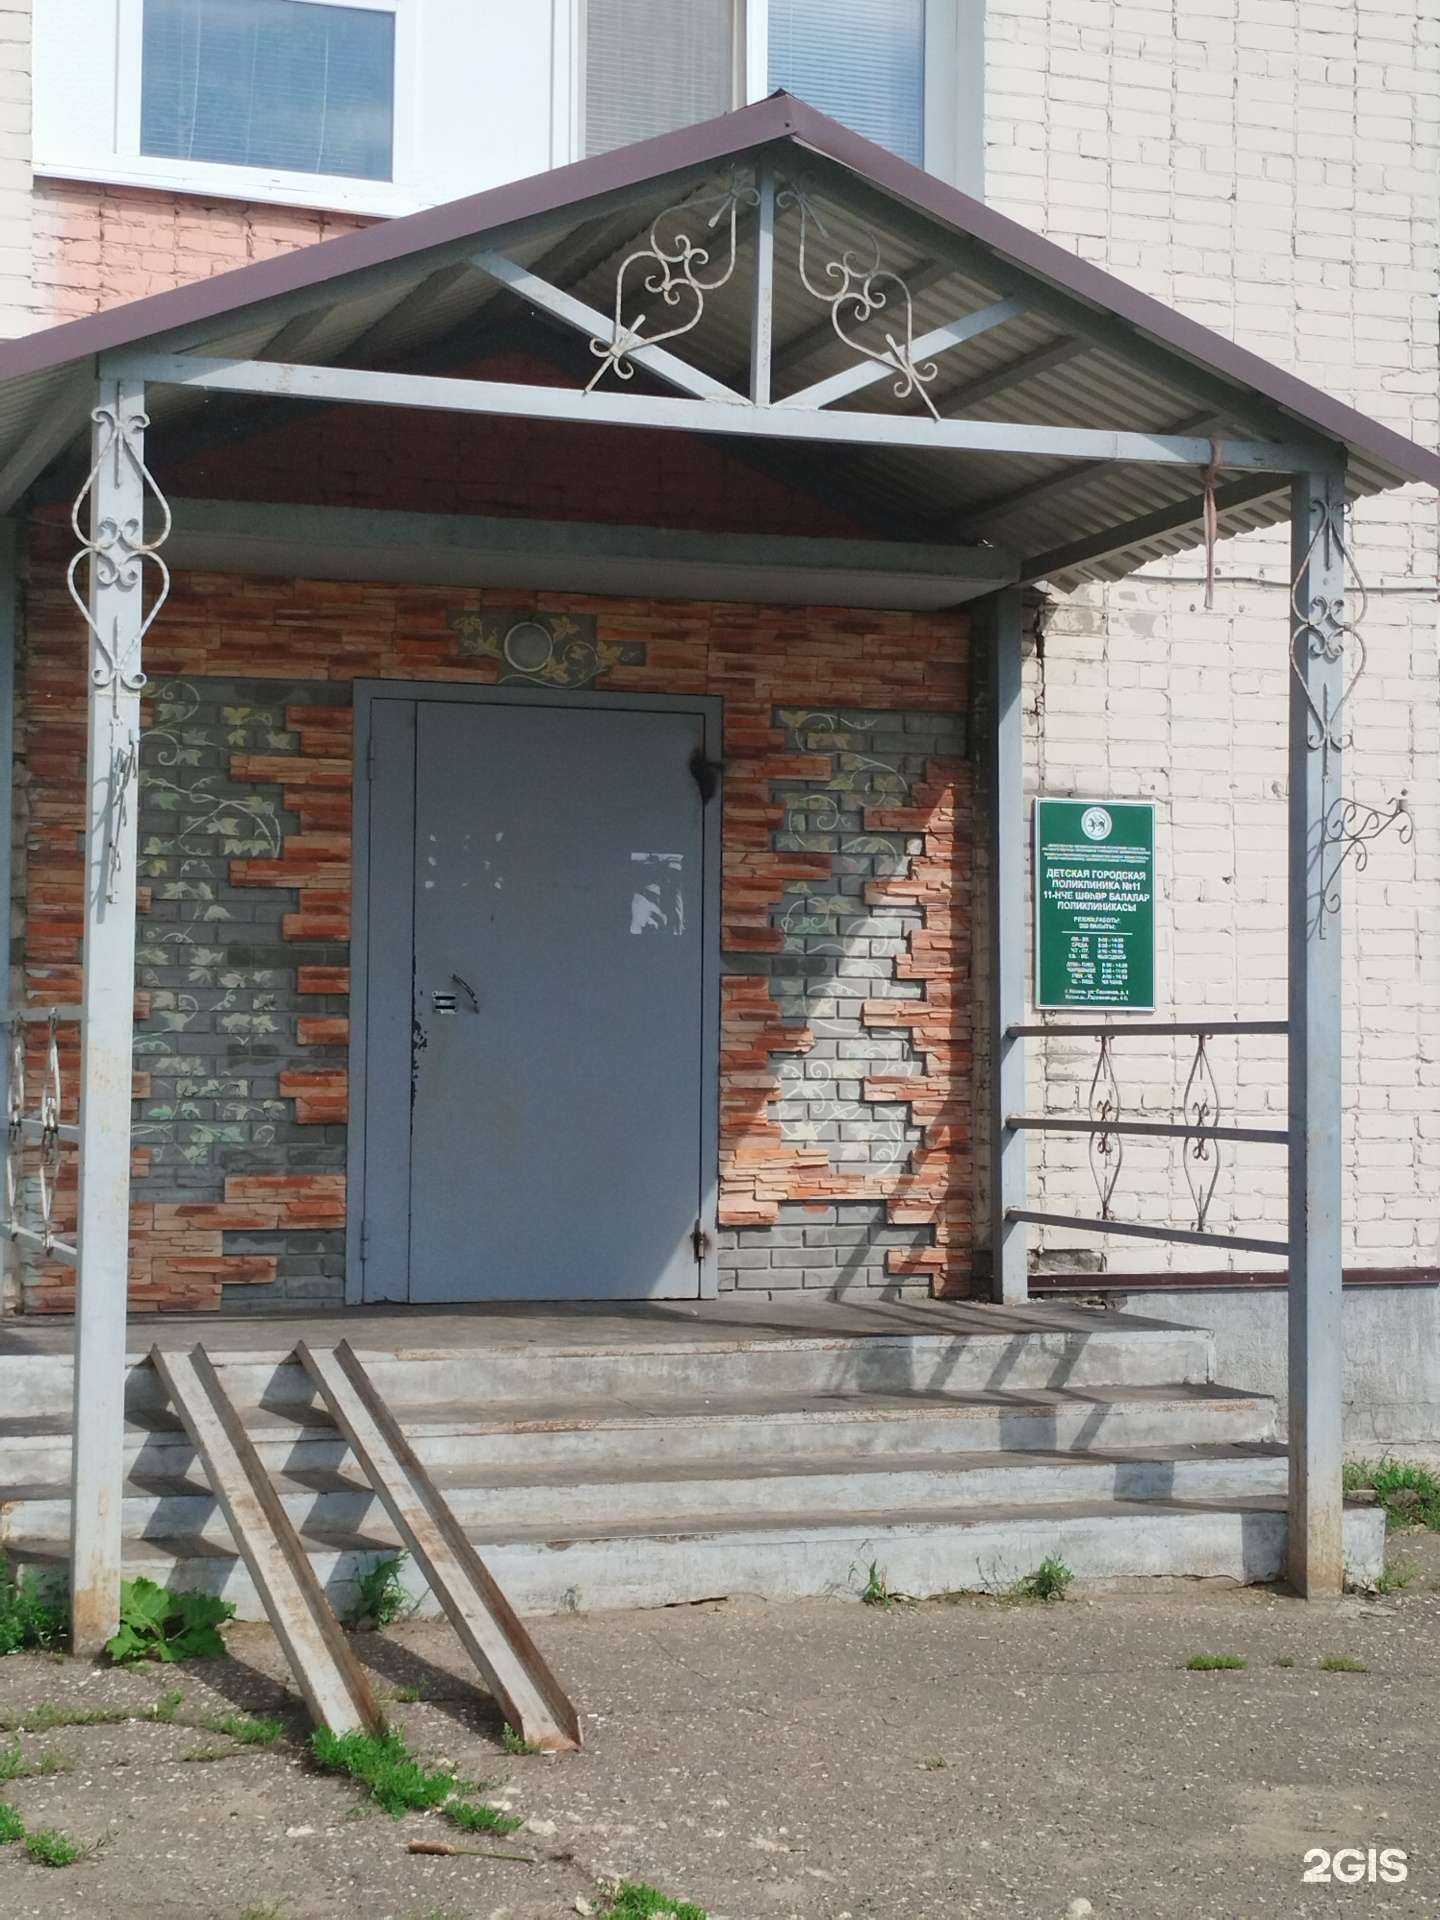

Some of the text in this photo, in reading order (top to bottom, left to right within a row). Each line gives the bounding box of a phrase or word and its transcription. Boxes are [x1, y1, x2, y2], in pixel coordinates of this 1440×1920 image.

[1046, 868, 1146, 880] ДЕТСКАЯ ГОРОДСКАЯ
[1052, 879, 1141, 891] ПОЛИКЛИНИКА №11
[1109, 892, 1150, 903] БАЛАЛАР
[1057, 901, 1137, 912] ПОЛИКЛИНИКАСЫ
